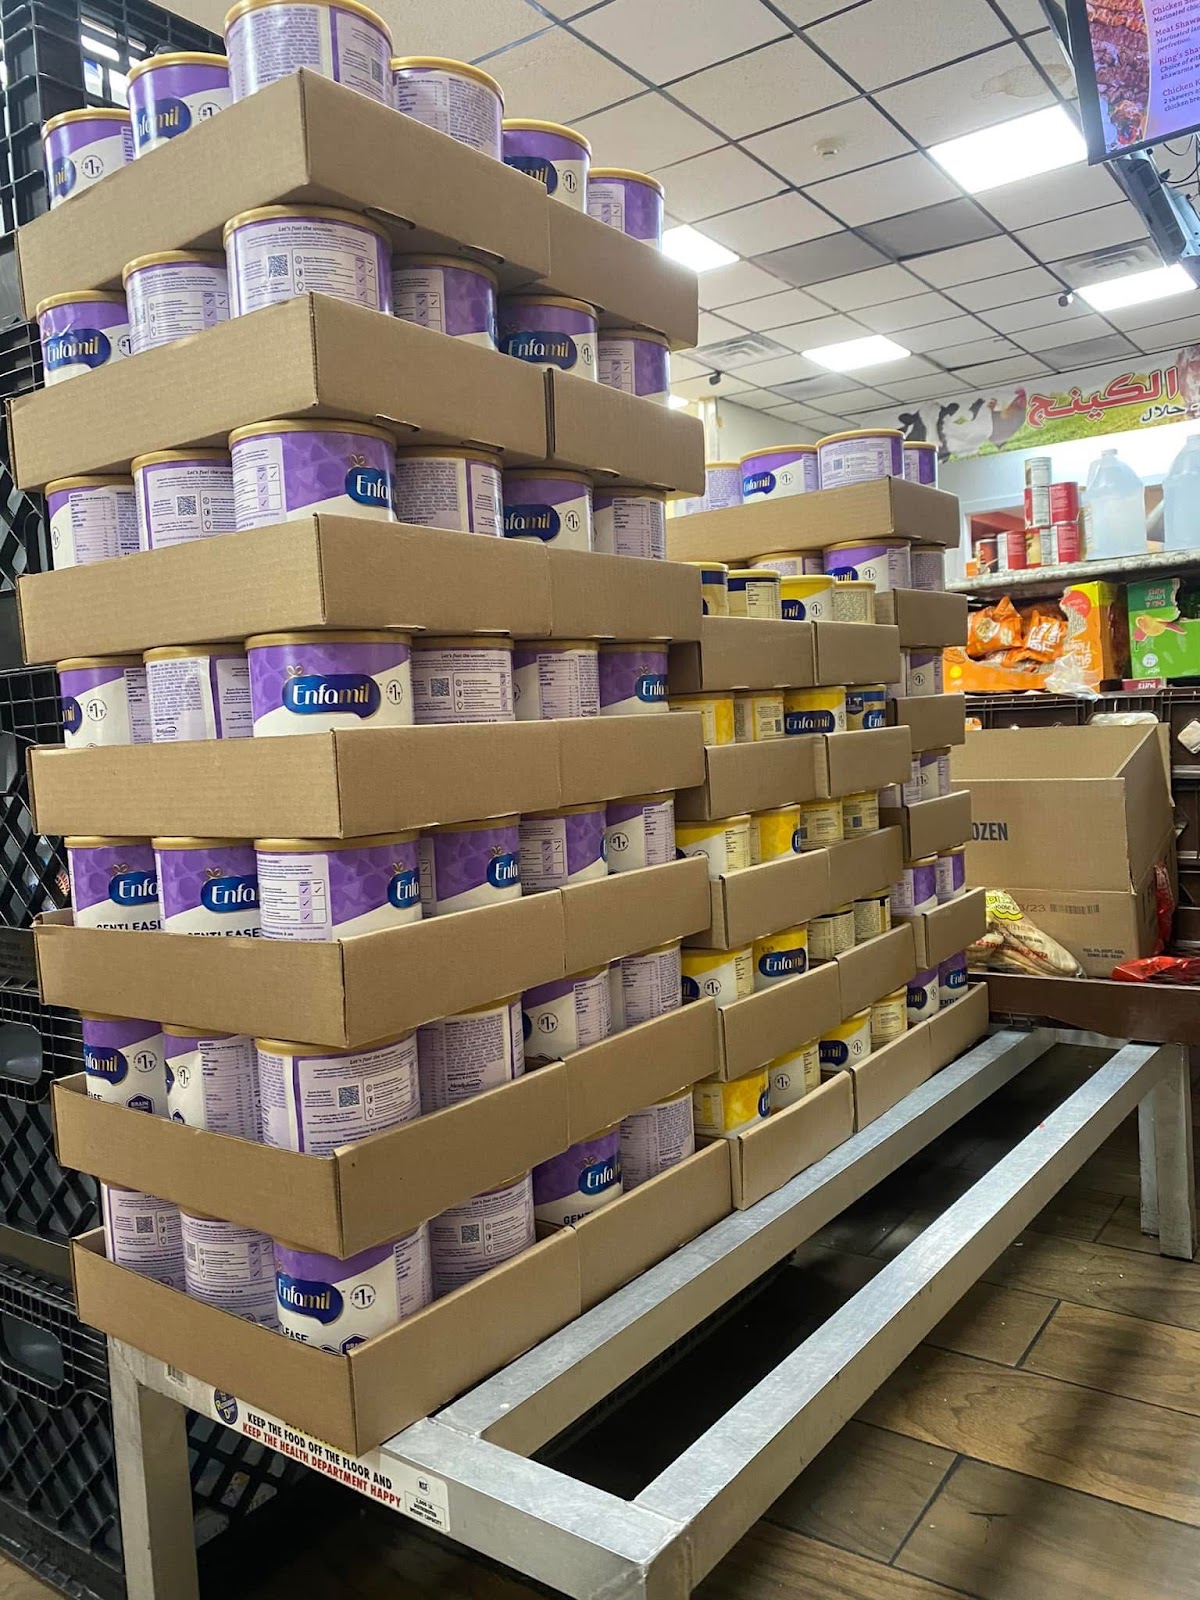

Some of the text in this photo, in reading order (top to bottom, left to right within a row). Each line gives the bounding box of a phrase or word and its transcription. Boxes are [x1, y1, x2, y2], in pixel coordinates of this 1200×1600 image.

[1152, 1, 1182, 16] Chicken
[1154, 7, 1186, 23] Marinated
[1156, 26, 1174, 37] Meat
[1156, 28, 1190, 45] Marinated
[1160, 62, 1180, 72] Choice
[1162, 82, 1194, 96] Chicken
[1164, 100, 1188, 112] chicken
[47, 336, 99, 363] Enfamil
[508, 340, 569, 358] Enfamil
[1027, 365, 1180, 429] الكينج
[1142, 404, 1186, 422] حلال
[356, 474, 391, 499] Enfa
[292, 683, 370, 706] Enfamil
[642, 680, 669, 696] Enfa
[786, 714, 830, 730] Enfamil
[211, 884, 256, 904] Enfa
[586, 1164, 618, 1188] Enfa
[278, 1278, 330, 1310] Enfamil
[248, 1412, 392, 1490] KEEP THE FOOD OFF THE FLOOR AND
[242, 1422, 261, 1439] KEEP
[264, 1432, 277, 1448] THE
[280, 1441, 308, 1463] HEALTH
[312, 1456, 368, 1492] DEPARTMENT
[370, 1484, 401, 1508] HAPPY
